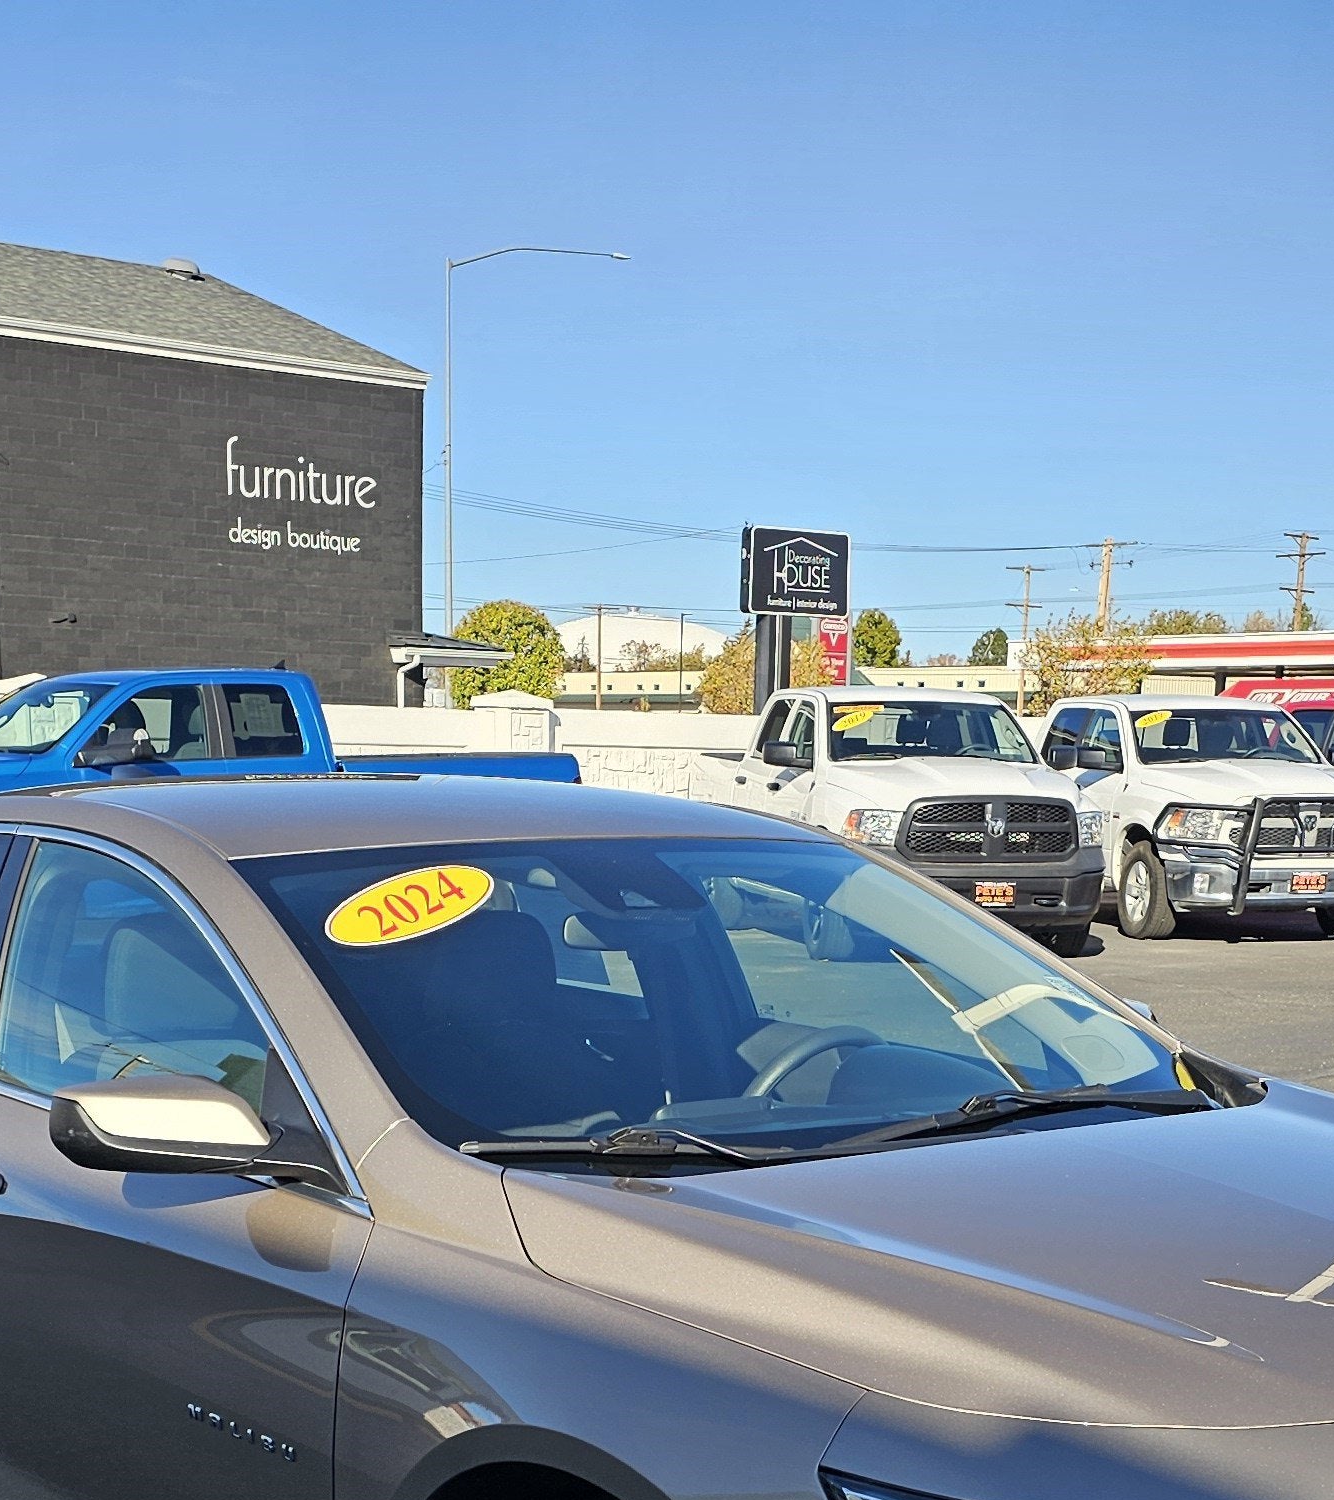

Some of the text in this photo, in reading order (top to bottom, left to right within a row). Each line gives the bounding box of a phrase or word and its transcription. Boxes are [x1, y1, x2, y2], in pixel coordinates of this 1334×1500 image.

[227, 435, 377, 509] furniture
[229, 517, 361, 556] design boutique
[788, 549, 830, 568] Decorating
[773, 546, 830, 594] HOUSE
[358, 871, 466, 938] 2024
